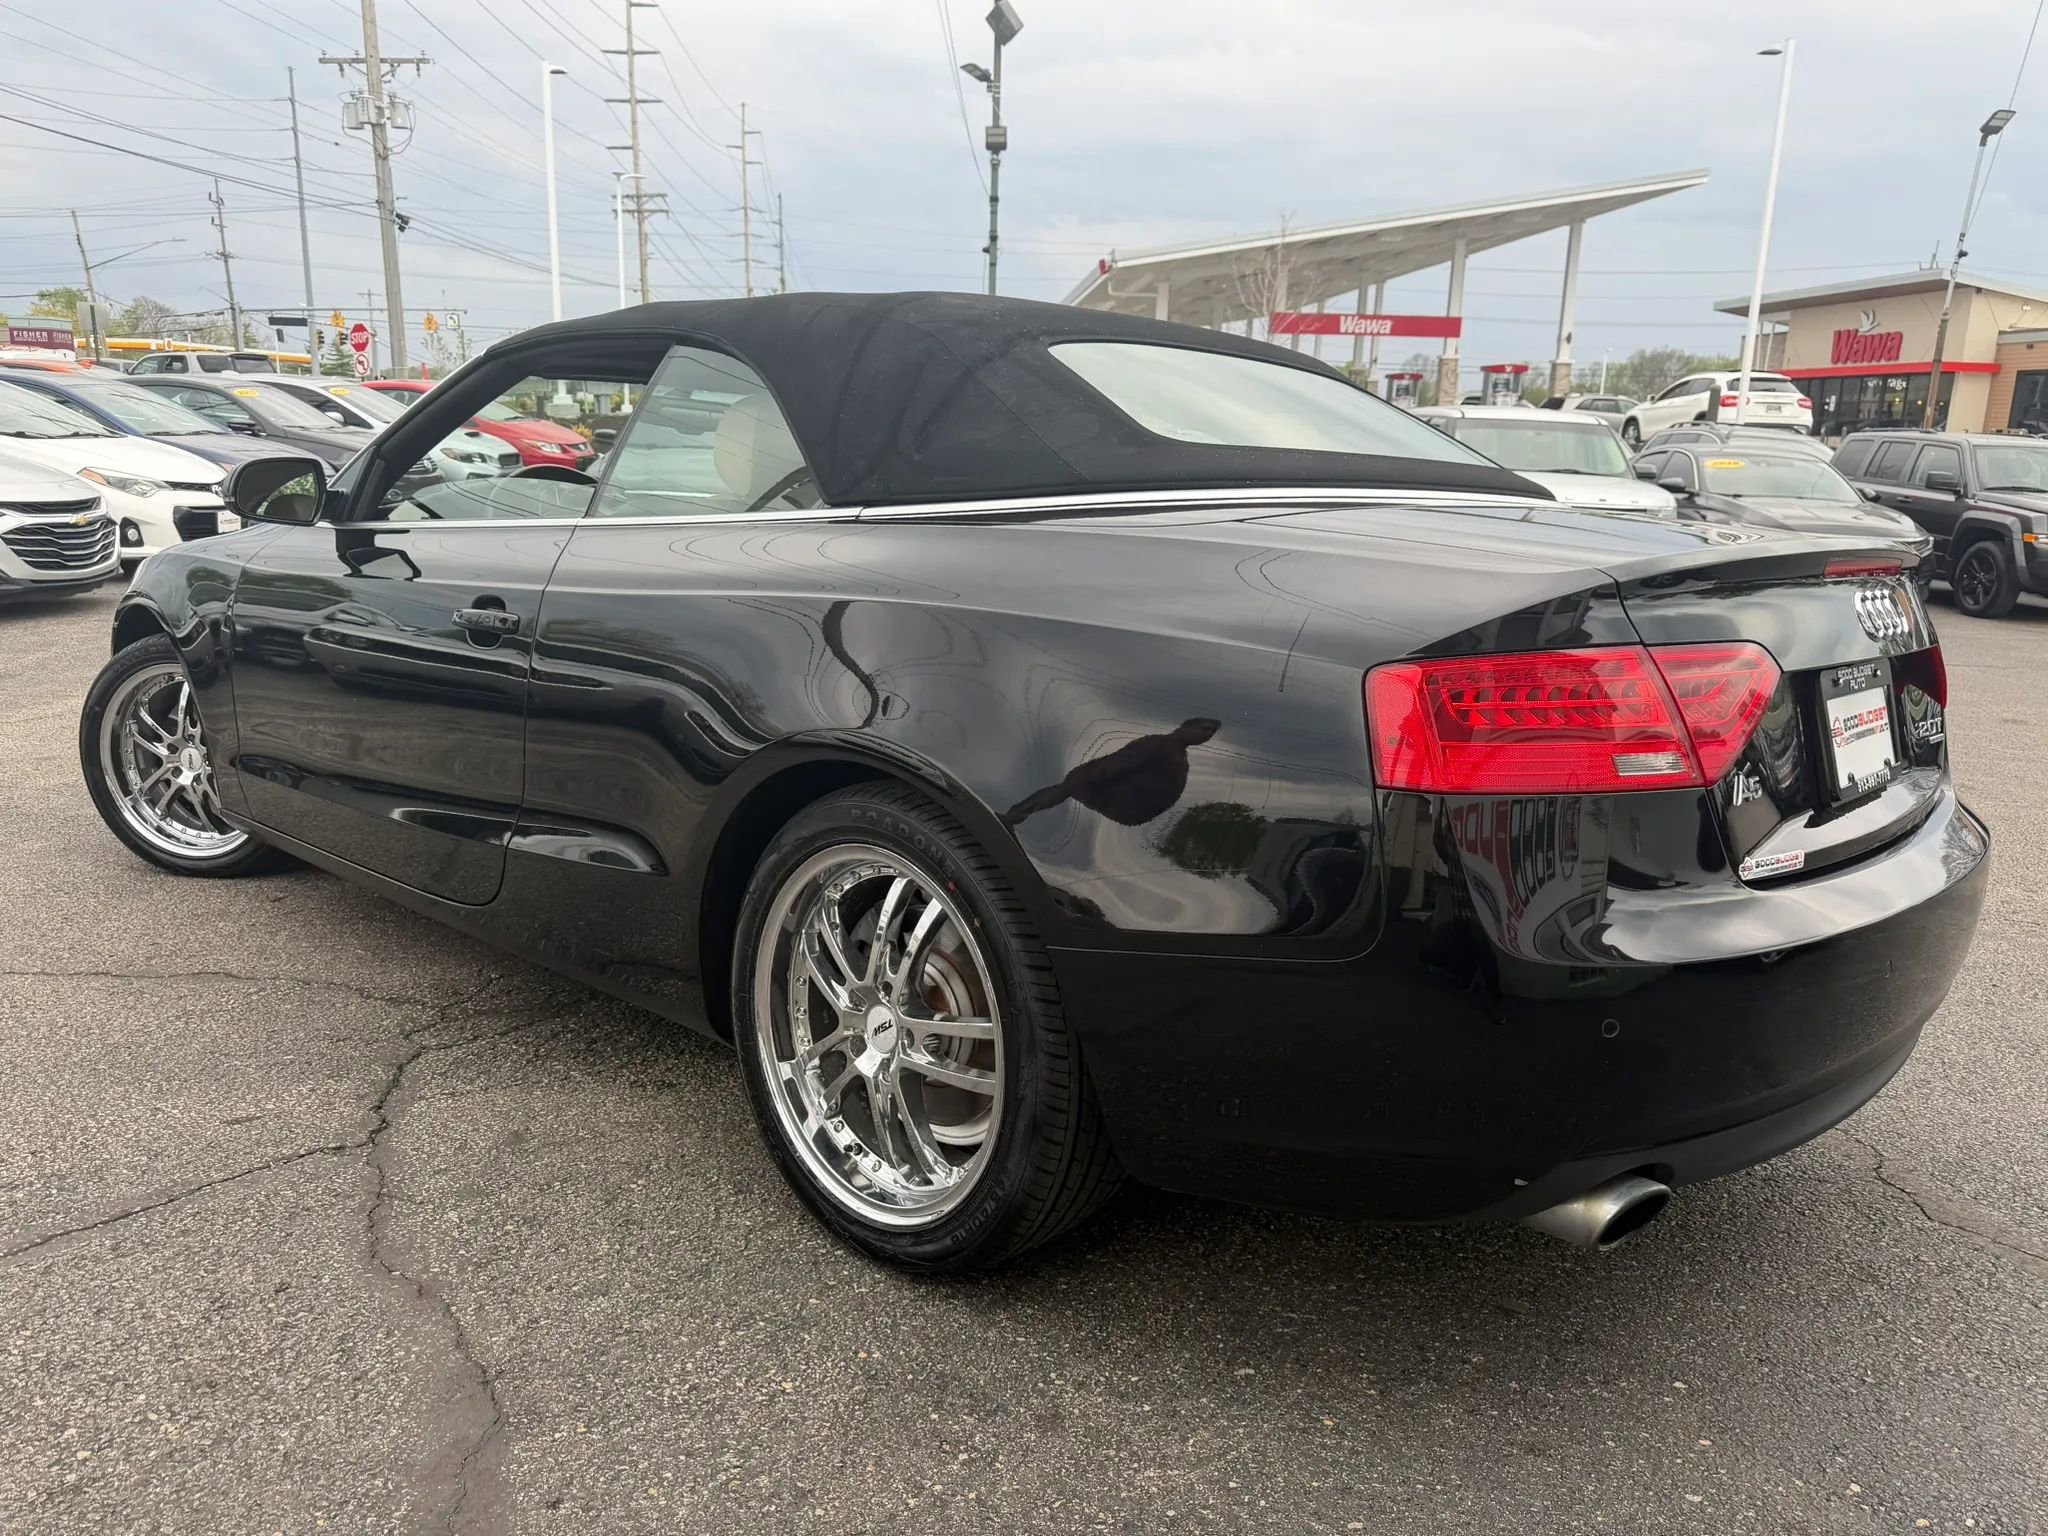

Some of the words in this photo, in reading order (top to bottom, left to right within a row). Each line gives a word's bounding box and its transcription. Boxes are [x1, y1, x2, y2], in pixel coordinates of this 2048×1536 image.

[1339, 315, 1393, 334] Wawa
[13, 330, 48, 339] FISHER
[351, 331, 369, 345] STOP
[1831, 329, 1904, 364] Wawa
[1733, 773, 1763, 806] A5
